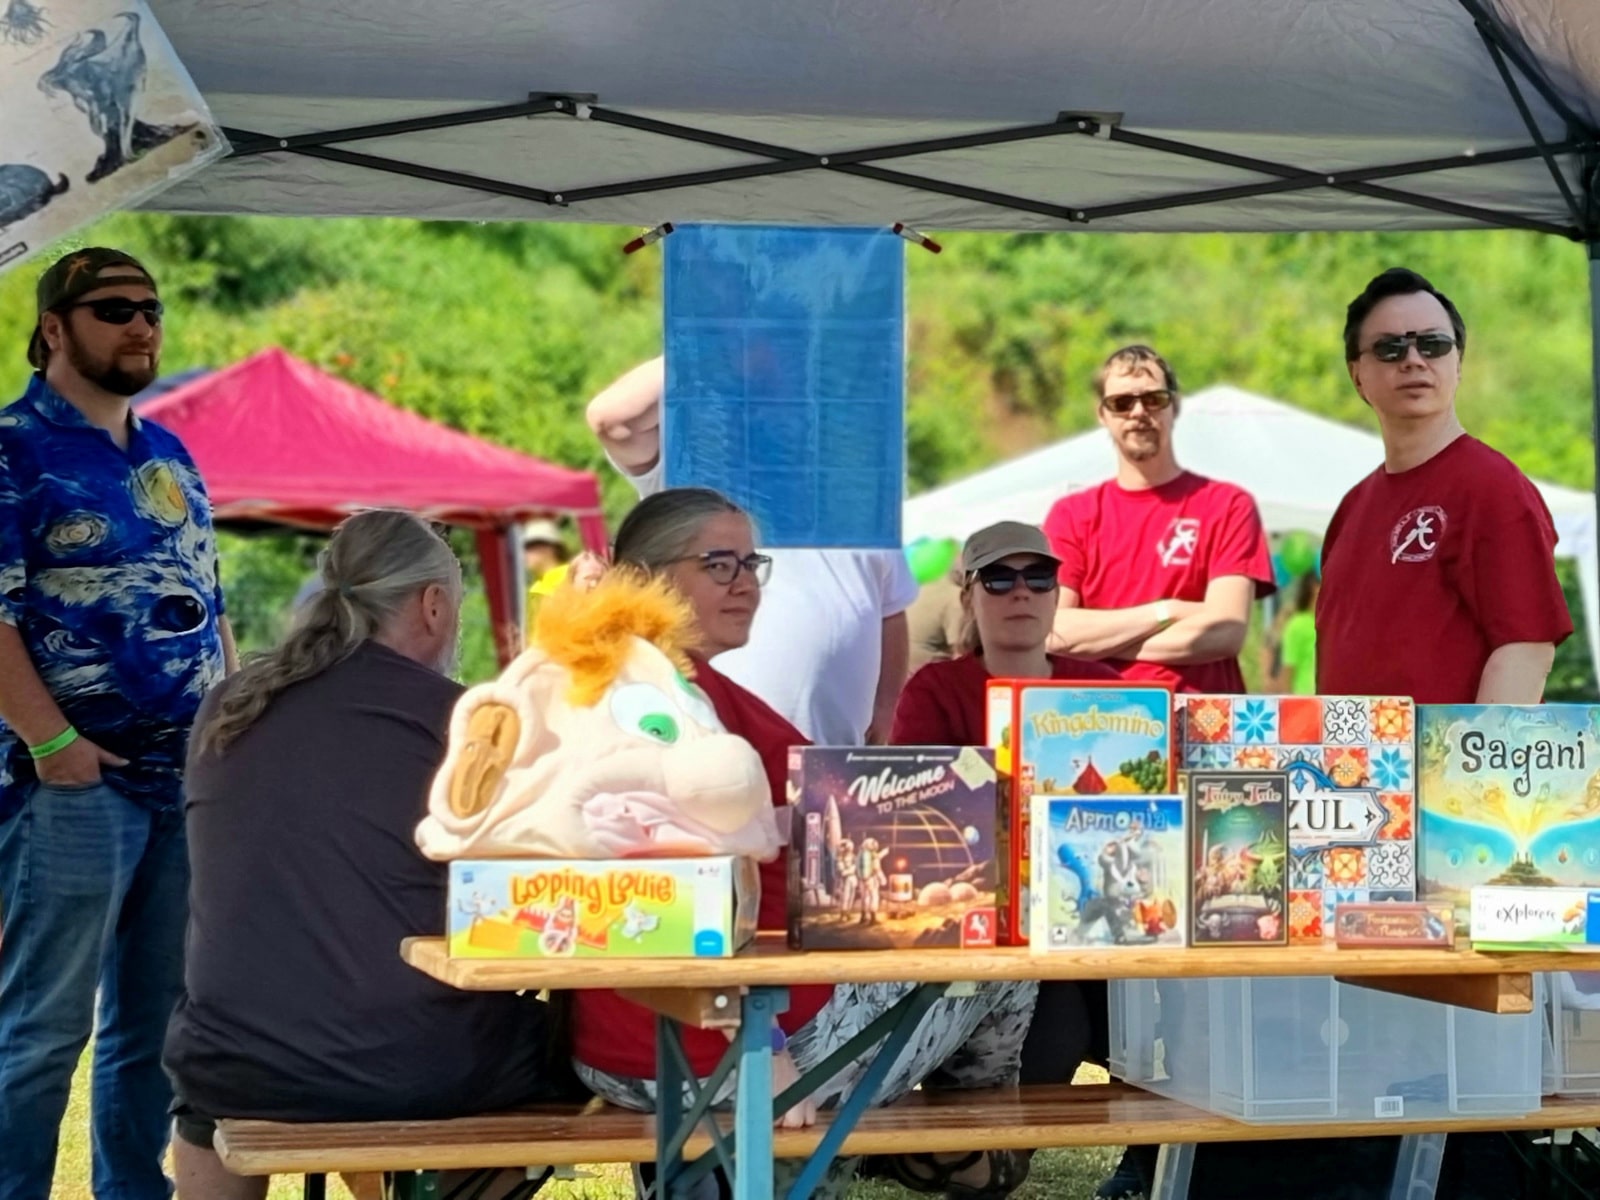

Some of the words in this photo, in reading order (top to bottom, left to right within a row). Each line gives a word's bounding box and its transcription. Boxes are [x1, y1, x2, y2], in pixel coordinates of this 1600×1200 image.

[1032, 704, 1164, 738] Kingdomino
[1460, 731, 1586, 797] Sagani
[847, 765, 946, 807] Welcome
[876, 801, 893, 815] TO
[896, 791, 918, 809] THE
[919, 779, 955, 800] MOON
[1065, 801, 1168, 832] Armonia
[1288, 799, 1354, 830] ZUL
[511, 868, 604, 914] Looping
[608, 872, 674, 905] Louie
